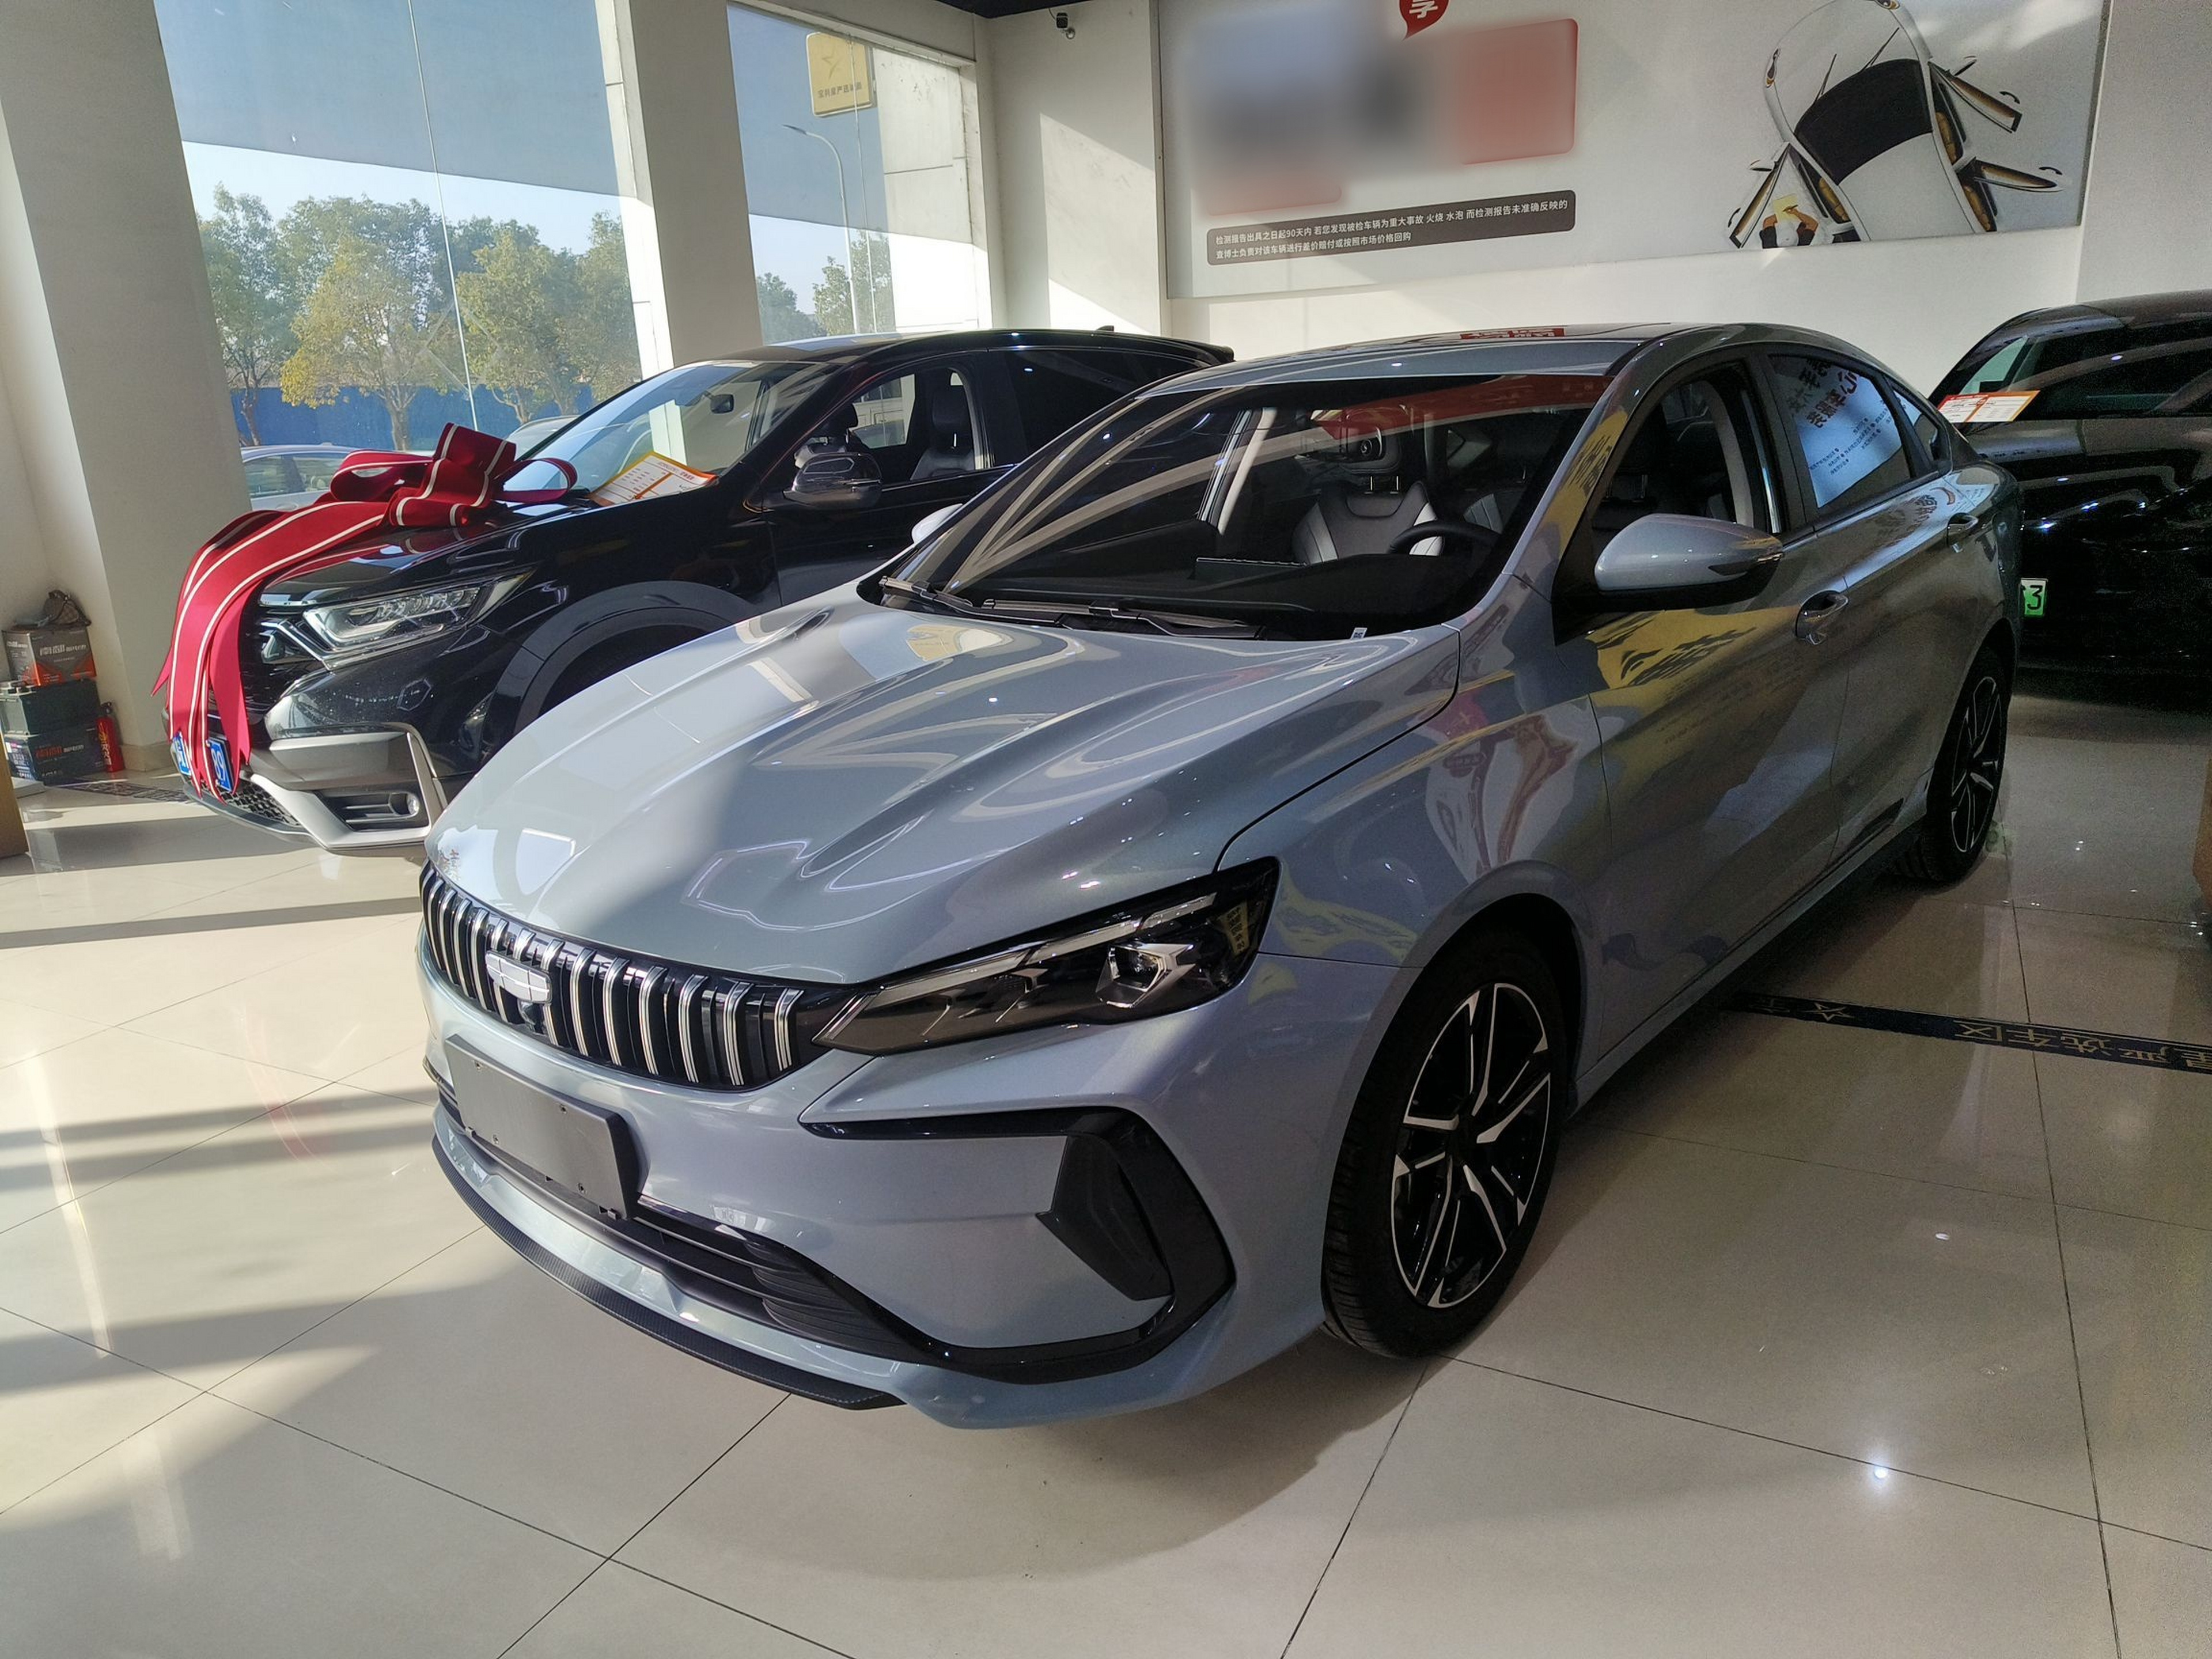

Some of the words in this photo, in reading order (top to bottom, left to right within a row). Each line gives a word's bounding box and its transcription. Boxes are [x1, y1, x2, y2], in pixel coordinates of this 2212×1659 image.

[1215, 227, 1312, 245] 检测报告出具之日起90天内
[1314, 214, 1424, 235] 若您发现被检车辆为重大事故
[1426, 213, 1444, 223] 火烧
[1446, 210, 1463, 221] 水泡
[1466, 200, 1567, 219] 而检测报告未准确反映的
[2022, 585, 2043, 610] 3
